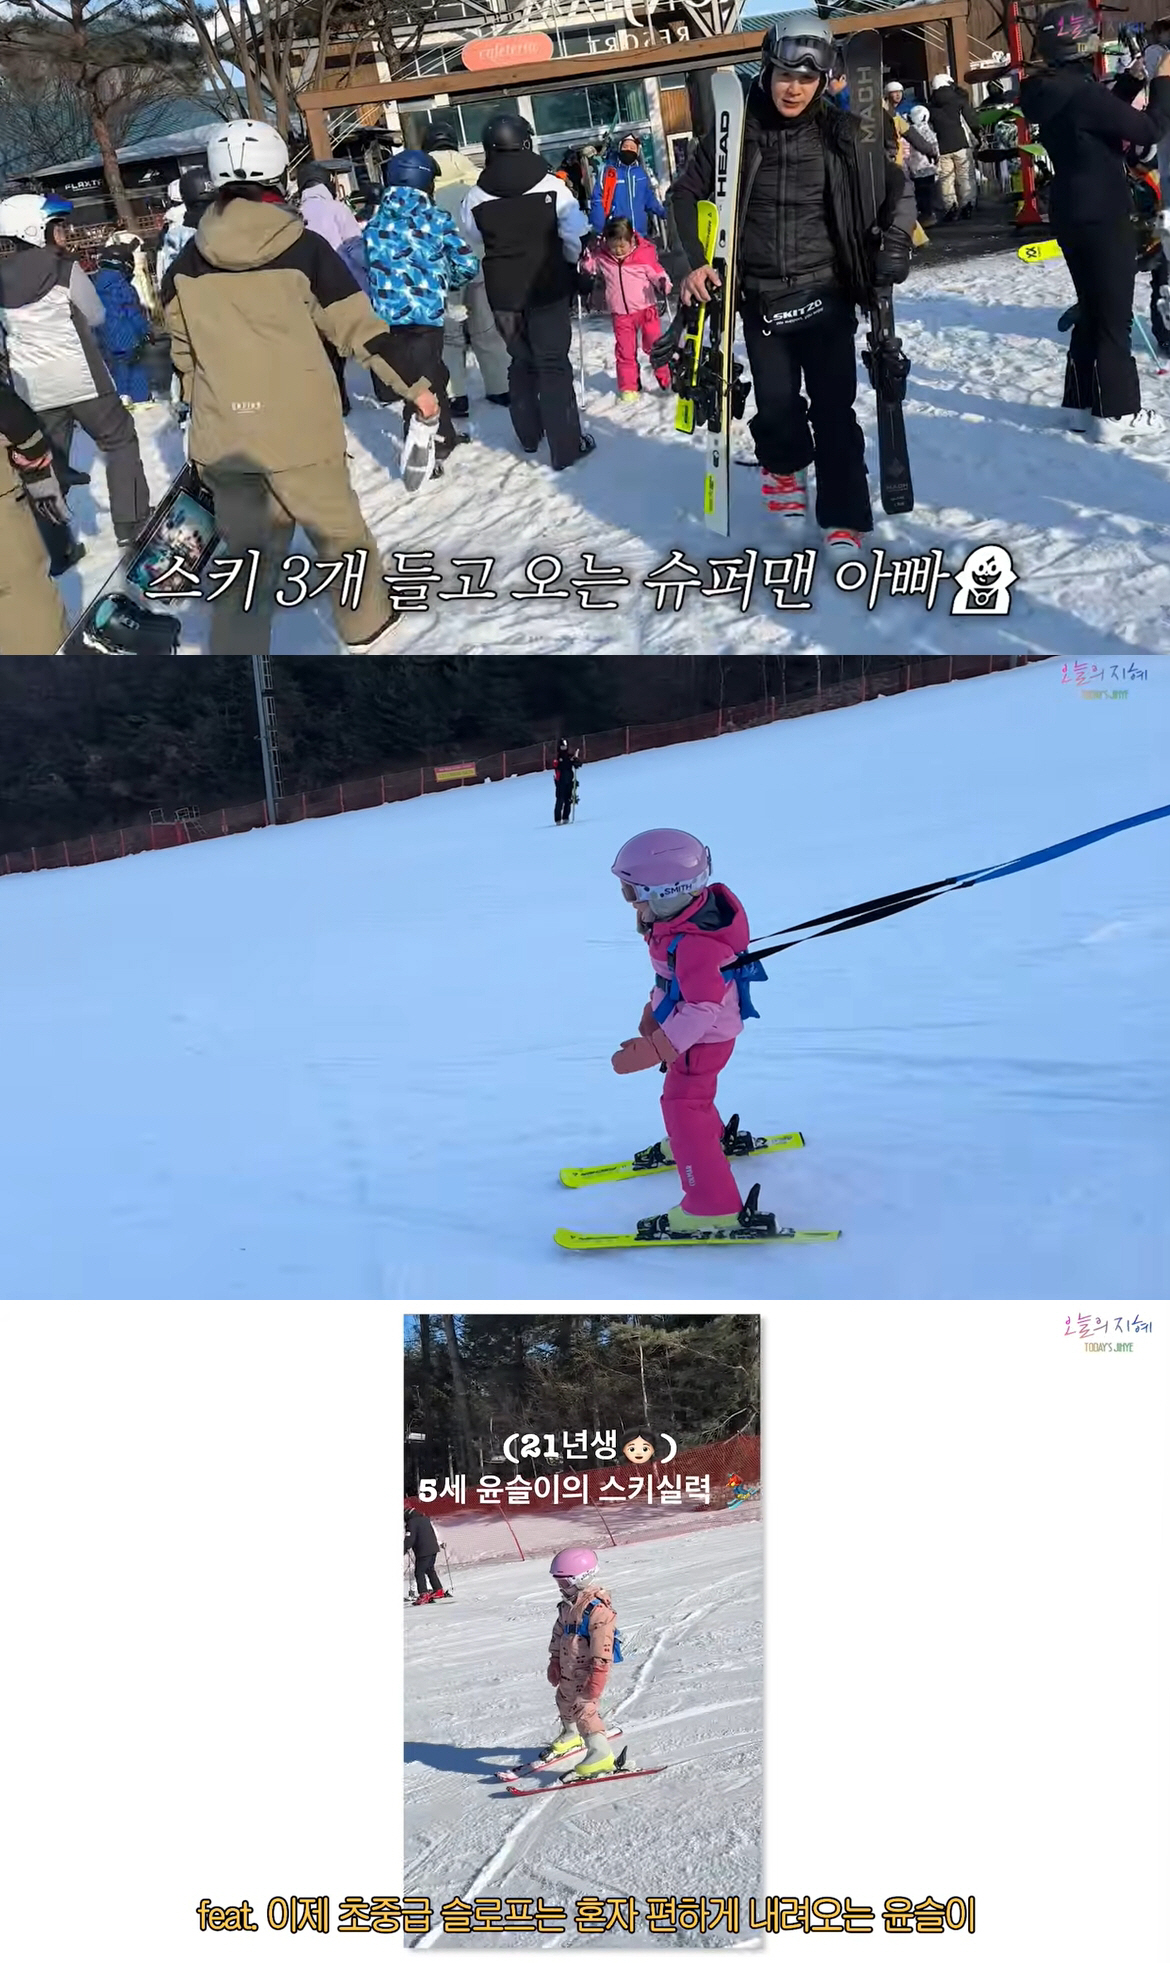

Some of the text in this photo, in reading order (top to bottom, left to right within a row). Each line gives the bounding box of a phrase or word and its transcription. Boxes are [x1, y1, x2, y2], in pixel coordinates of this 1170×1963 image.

[856, 65, 878, 144] MACH
[716, 110, 731, 197] HEAD
[772, 298, 823, 321] SKITZO
[664, 883, 692, 896] SMITH
